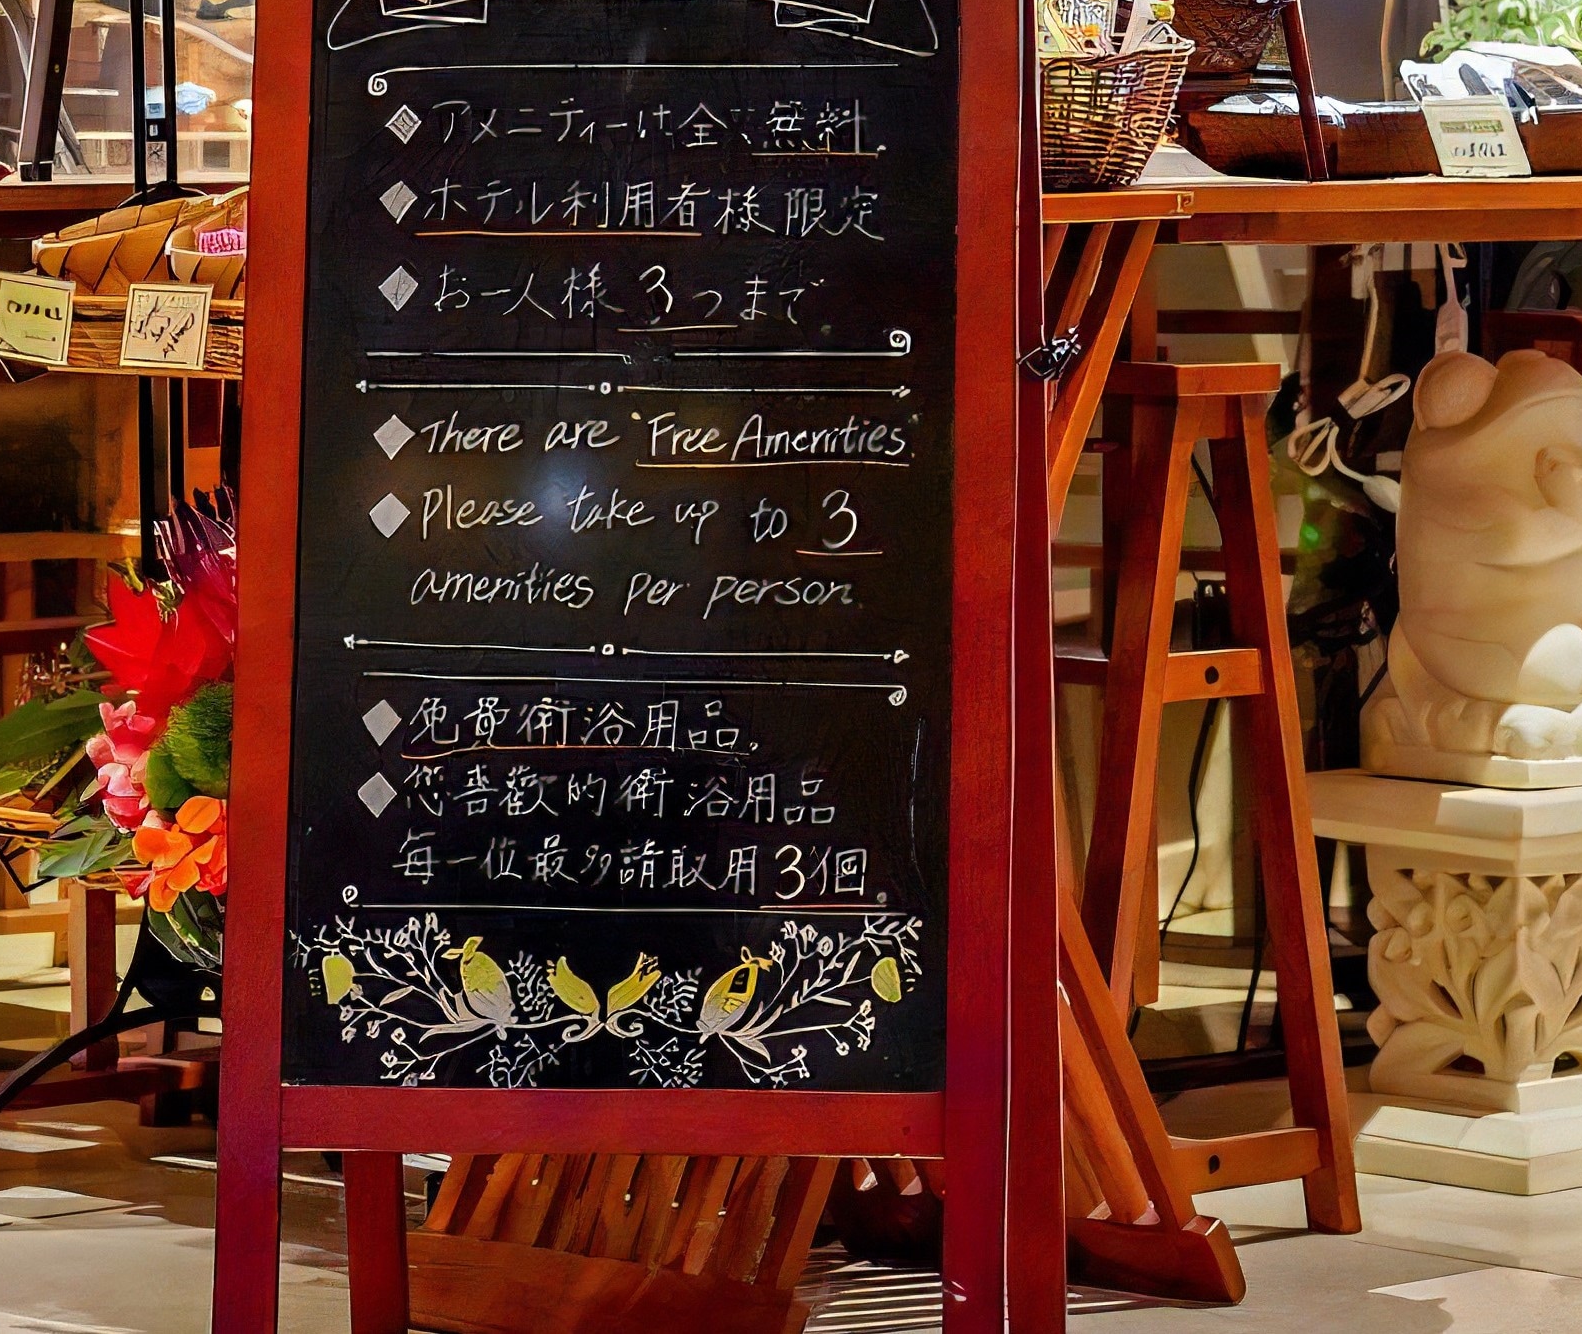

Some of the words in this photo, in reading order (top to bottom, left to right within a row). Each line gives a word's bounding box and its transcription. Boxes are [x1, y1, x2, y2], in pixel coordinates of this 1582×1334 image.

[422, 176, 885, 242] ホテル利用者様限定
[420, 410, 524, 454] There
[544, 418, 621, 451] are
[420, 483, 544, 542] Please
[565, 482, 655, 533] take
[675, 500, 720, 546] up
[749, 497, 788, 542] to
[820, 488, 858, 550] 3
[409, 561, 596, 609] amenities
[623, 572, 684, 616] per
